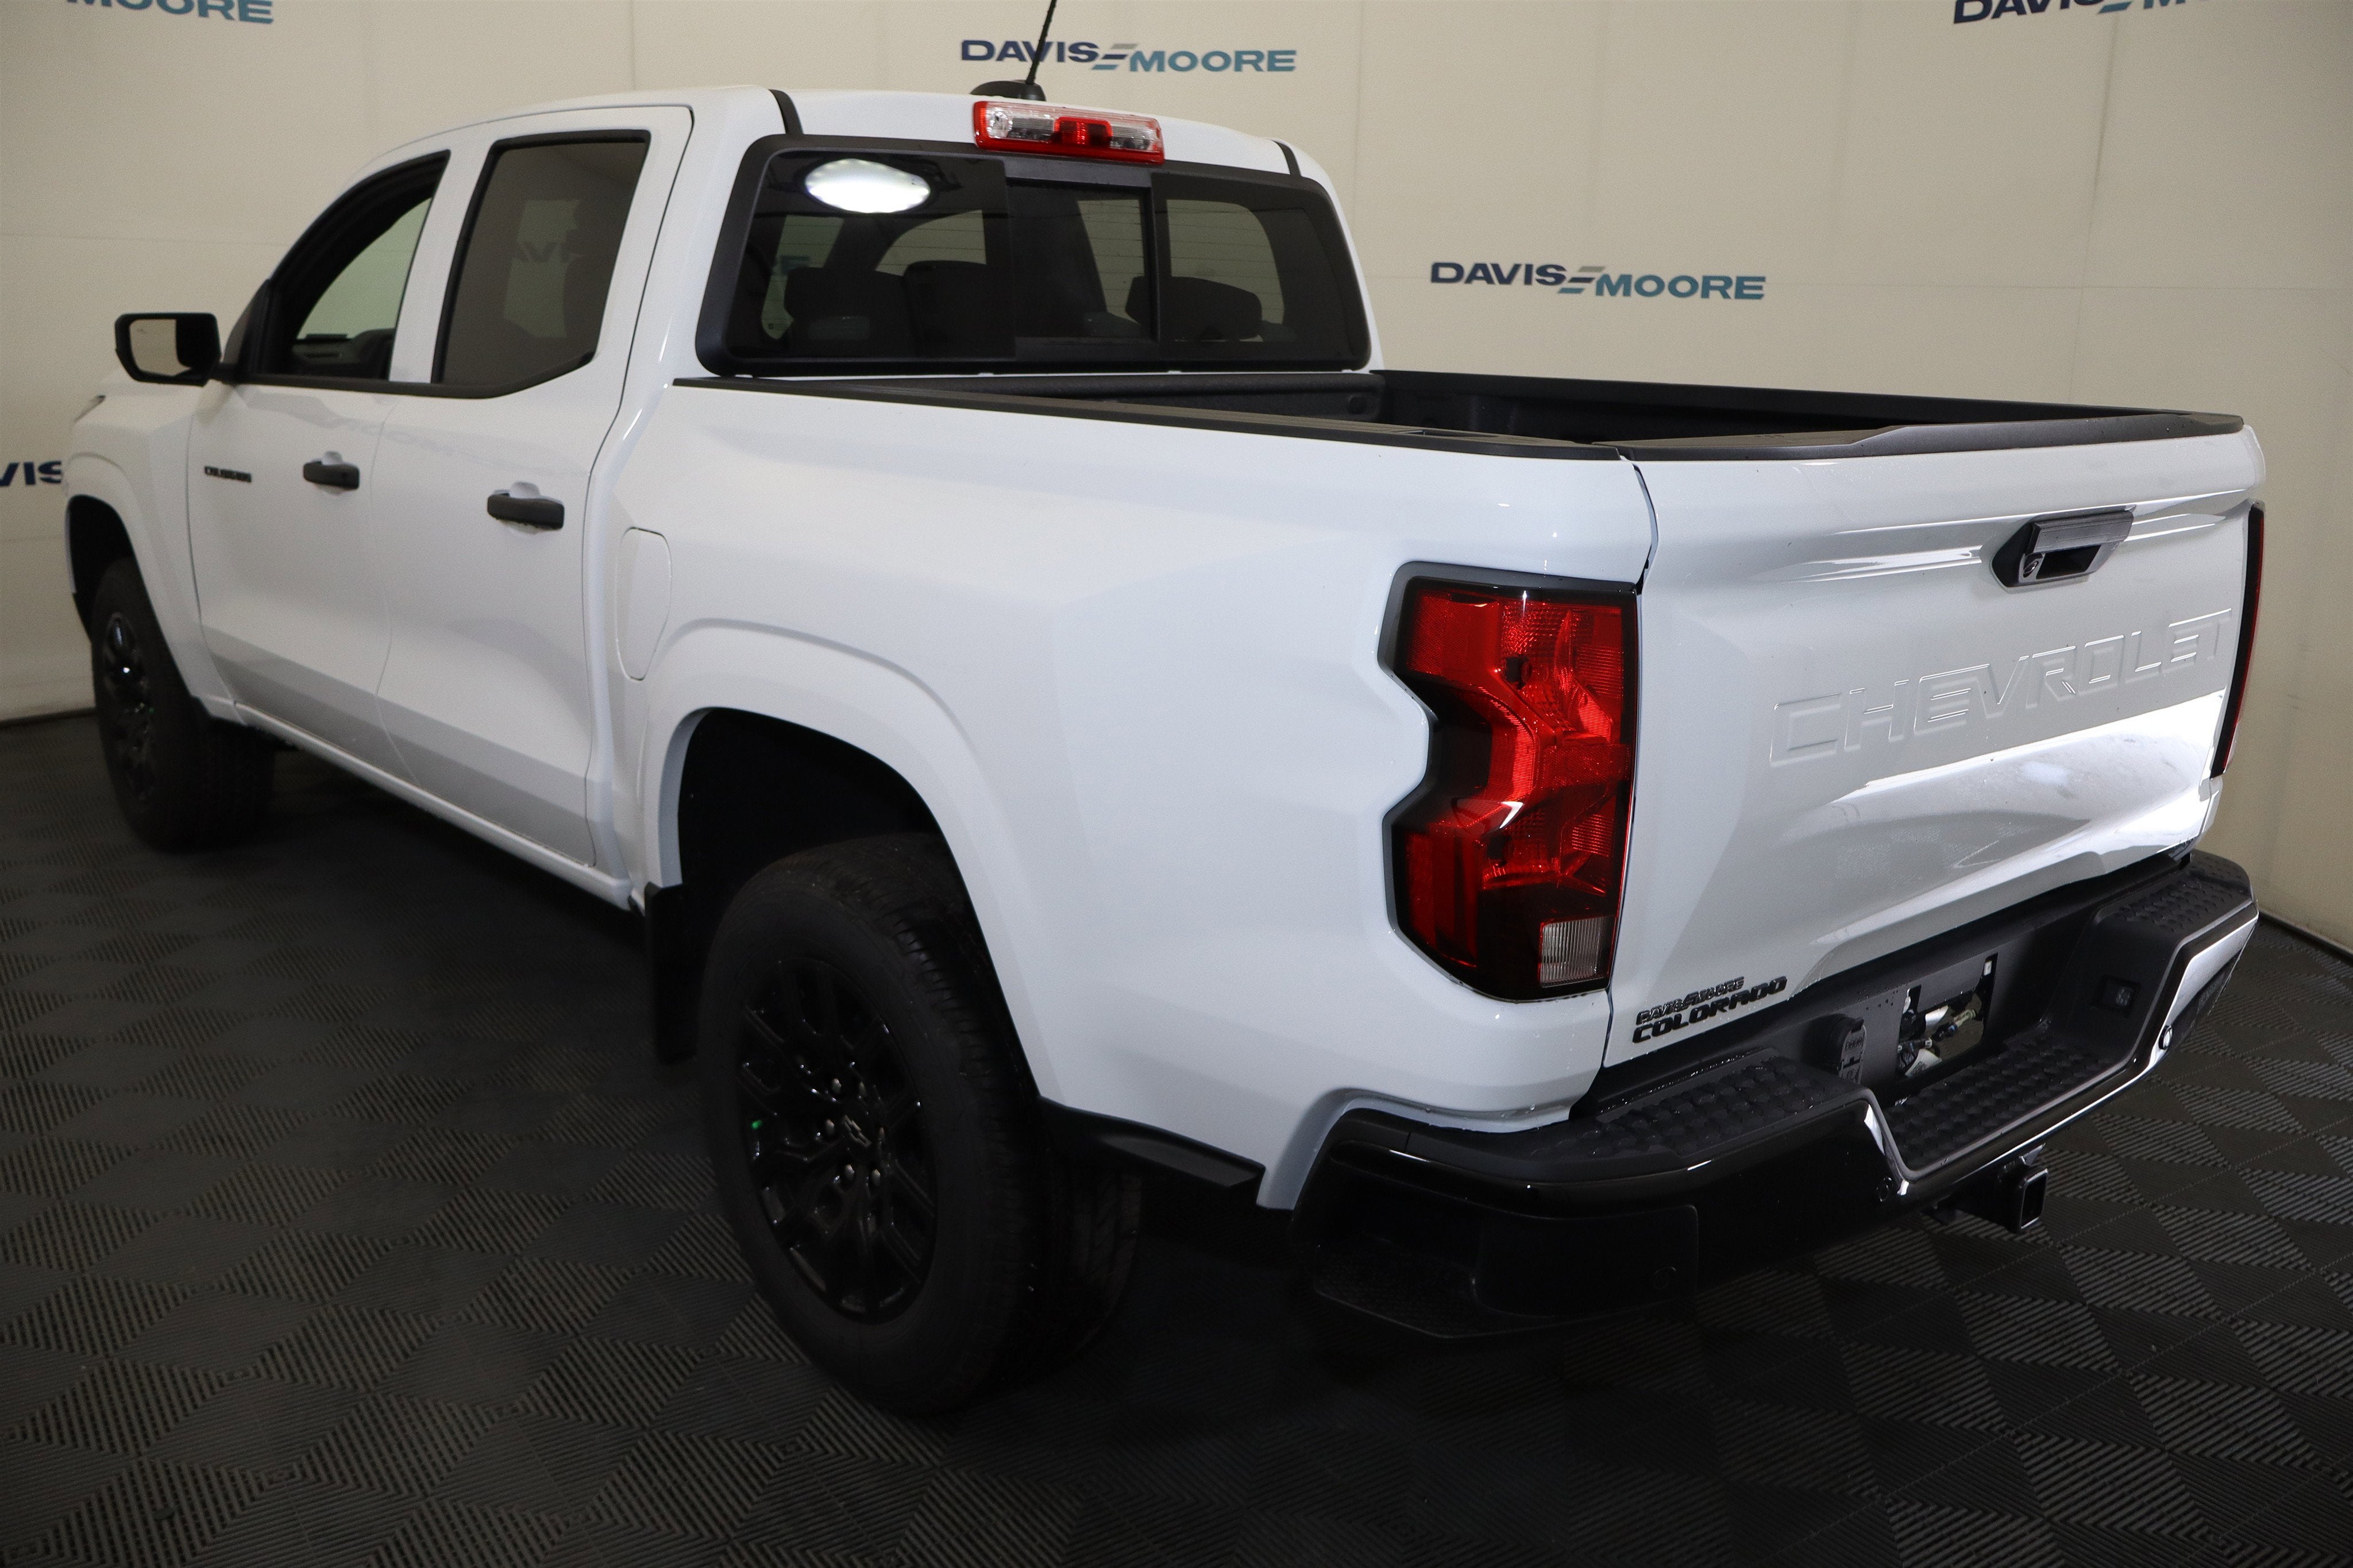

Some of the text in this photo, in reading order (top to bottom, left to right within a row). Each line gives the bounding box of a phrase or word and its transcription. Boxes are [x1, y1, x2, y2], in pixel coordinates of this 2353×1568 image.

[1953, 0, 2105, 24] DAV
[961, 40, 1297, 73] DAVIS MOORE
[1430, 261, 1766, 300] DAVIS MOORE
[0, 461, 62, 486] VIS
[1768, 608, 2232, 768] CHEVROLET
[1632, 975, 1788, 1044] COLORADO
